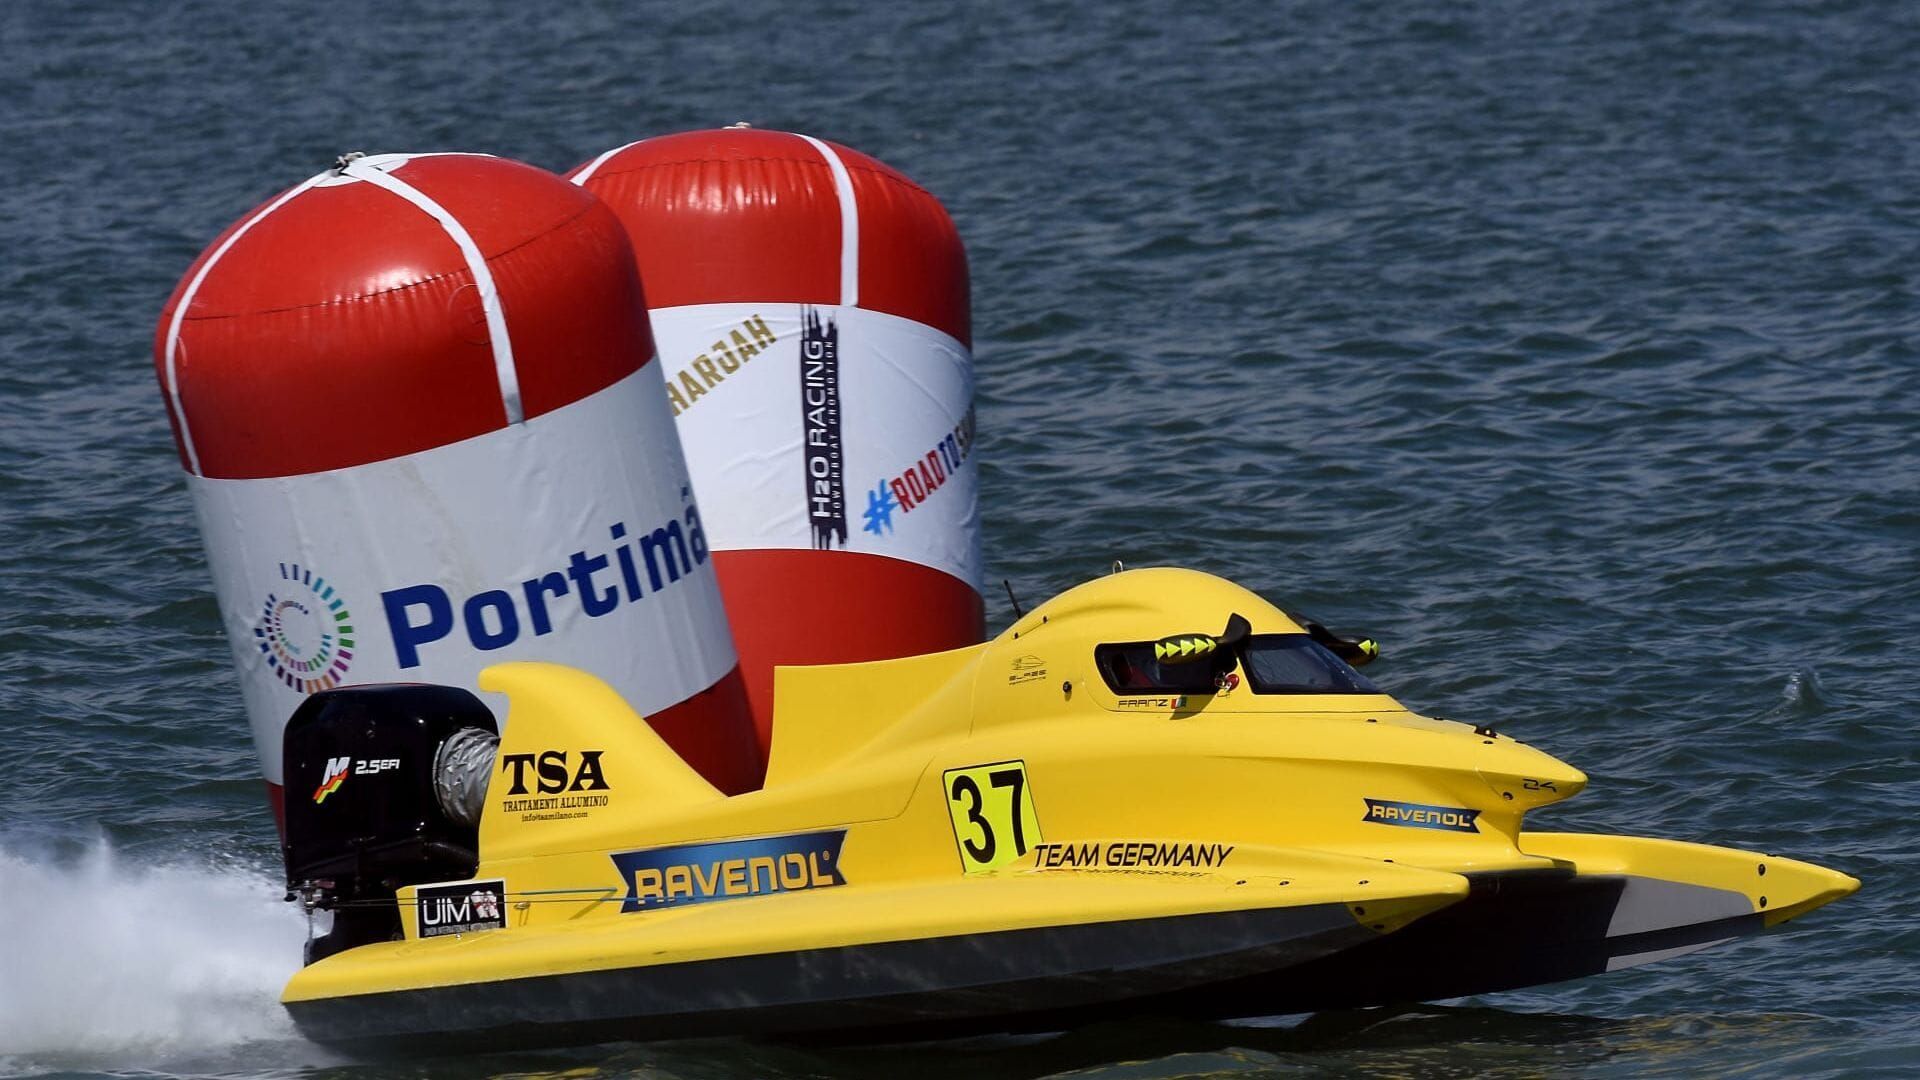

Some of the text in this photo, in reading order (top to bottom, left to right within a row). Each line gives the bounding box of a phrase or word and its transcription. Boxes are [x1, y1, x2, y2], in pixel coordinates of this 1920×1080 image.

[803, 340, 832, 518] H2O RACING
[823, 341, 842, 519] POWERBOAT PROMOTION
[1118, 699, 1168, 708] FRANZ
[502, 750, 611, 795] TSA
[1523, 778, 1557, 792] 24
[503, 795, 609, 813] TRATTAMENTI ALLUMINIO
[950, 768, 1025, 864] 37
[1371, 804, 1472, 828] RAVENOL
[1034, 842, 1235, 868] TEAM GERMANY
[422, 895, 471, 926] UIM
